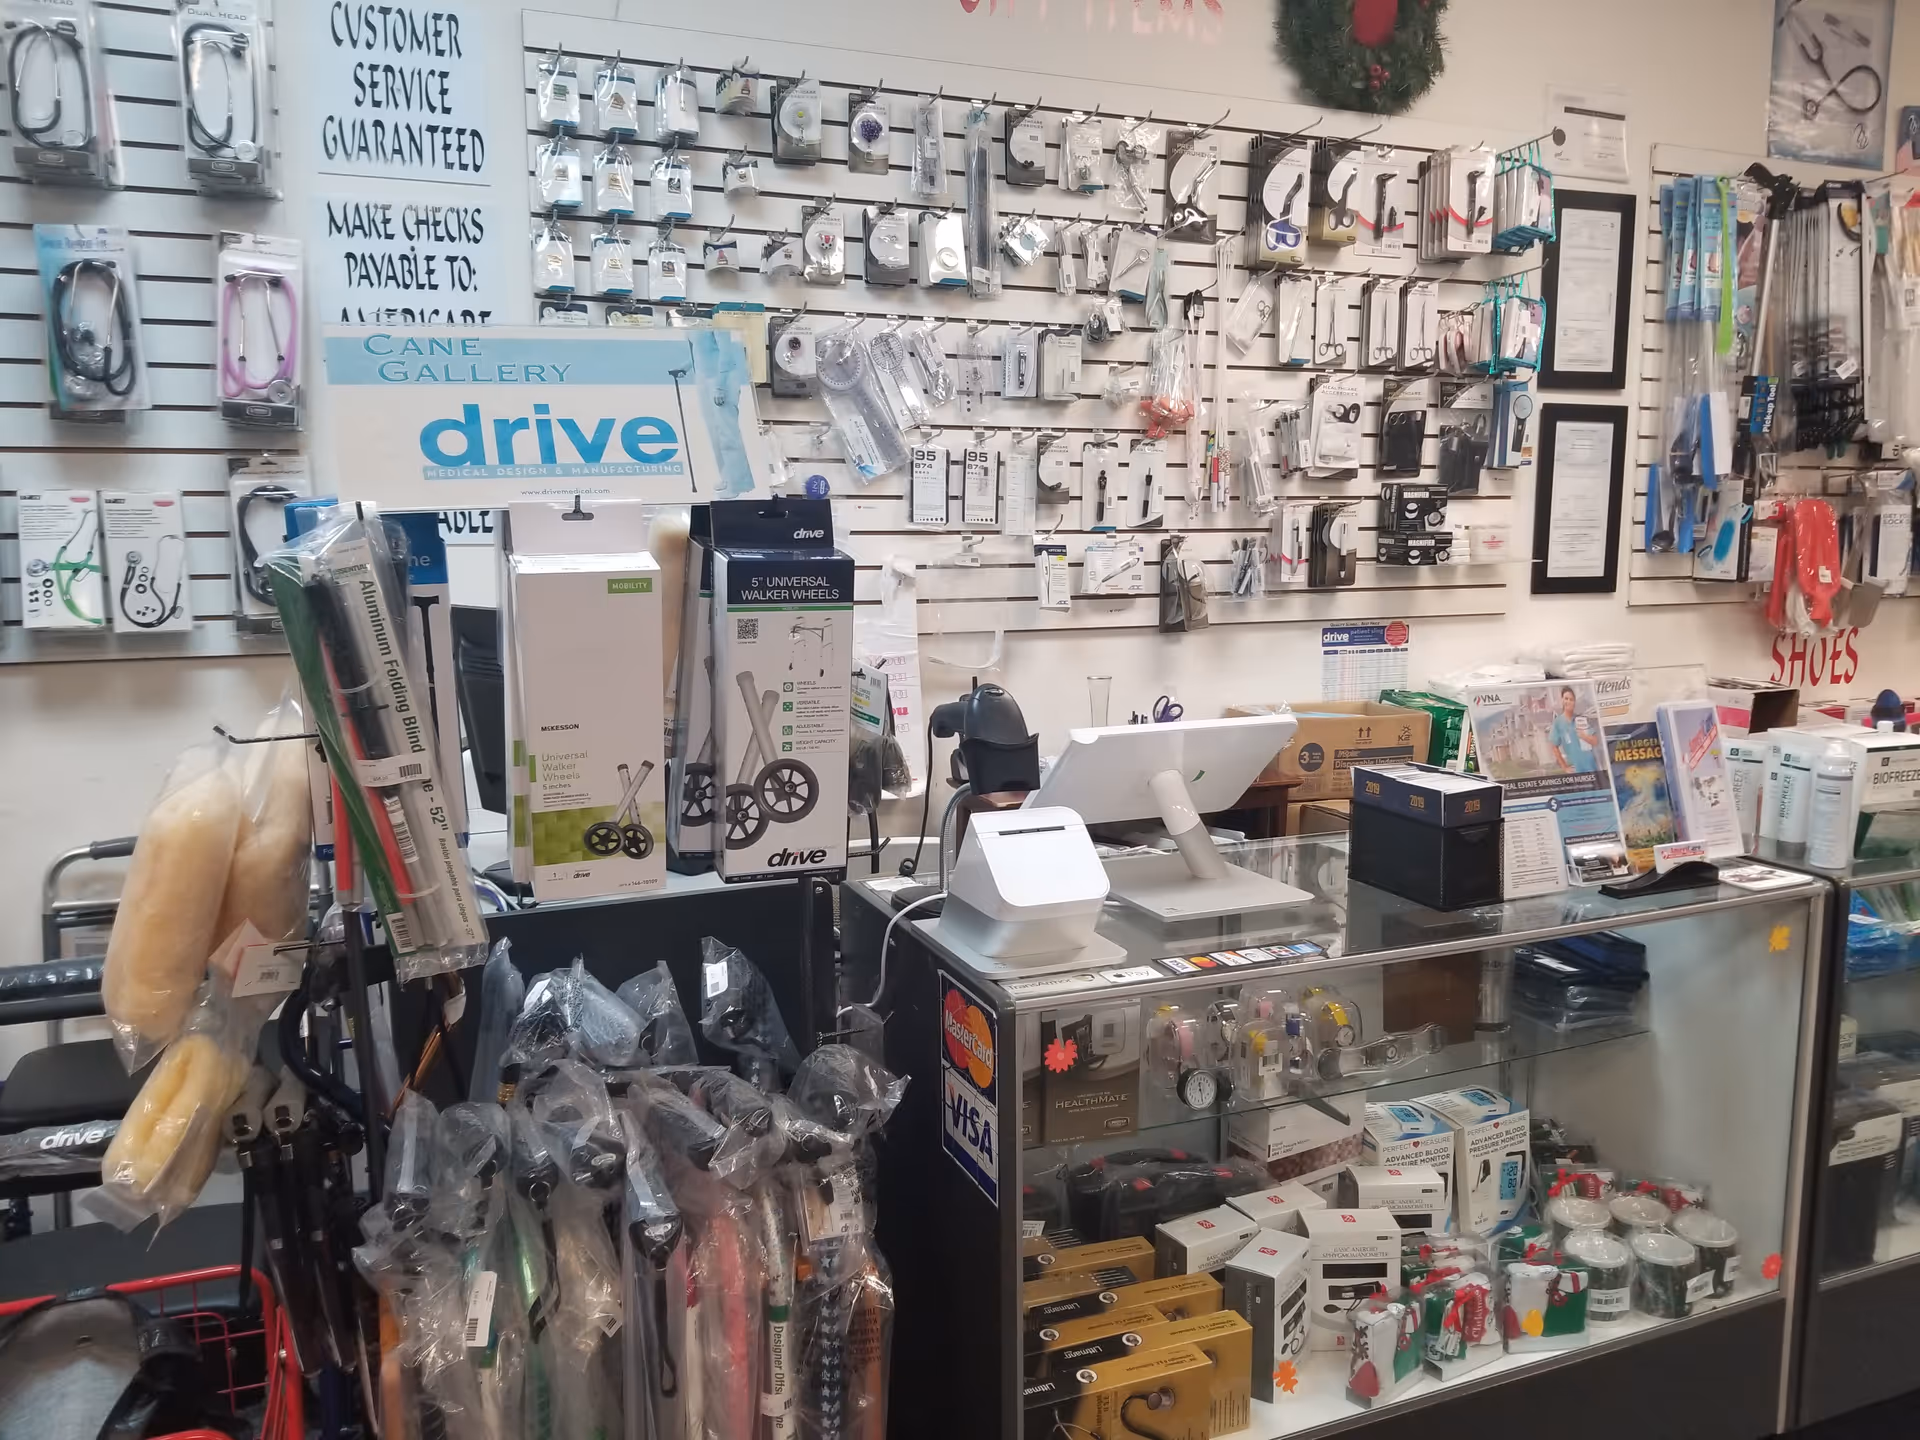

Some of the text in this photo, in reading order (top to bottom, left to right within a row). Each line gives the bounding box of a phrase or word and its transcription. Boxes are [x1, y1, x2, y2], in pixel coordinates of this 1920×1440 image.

[187, 7, 247, 21] DUAL HEAD
[330, 1, 462, 59] CUSTOMER
[353, 61, 452, 115] SERVICE
[322, 115, 485, 173] GUARANTEED
[326, 200, 484, 245] MAKE CHECKS
[343, 251, 478, 292] PAYABLE TO:
[362, 332, 482, 356] CANE
[377, 360, 572, 383] GALLERY
[1762, 384, 1777, 432] Pick-up Tool
[419, 403, 679, 467] drive
[915, 450, 936, 461] 95
[968, 451, 988, 462] 95
[426, 467, 488, 478] MEDICAL
[497, 466, 547, 476] DESIGN
[571, 463, 682, 475] MANUFACTURING
[793, 528, 824, 541] drive
[612, 582, 648, 591] MOBILITY
[766, 576, 830, 587] UNIVERSAL
[741, 589, 840, 600] WALKER WHEELS
[1323, 632, 1349, 641] drive
[1770, 626, 1859, 687] SHOES
[358, 579, 393, 657] Aluminum
[384, 660, 410, 713] Folding
[402, 716, 426, 754] Blind
[1480, 694, 1501, 704] VNA
[541, 750, 588, 762] Universal
[1300, 751, 1309, 764] 3
[542, 762, 576, 772] Walker
[543, 772, 581, 782] Wheels
[1518, 781, 1537, 789] ESTATE
[1539, 778, 1562, 787] SAVINGS
[1574, 774, 1596, 783] NURSES
[1873, 770, 1920, 785] BIOFREEZE
[1779, 775, 1792, 818] BIOFREEZE
[767, 847, 827, 867] drive
[573, 871, 591, 879] drive
[1008, 978, 1072, 992] TransArmor
[944, 1009, 992, 1070] MasterCard
[1055, 1093, 1128, 1109] HEALTHMATE
[948, 1090, 993, 1166] VISA
[1467, 1115, 1527, 1136] PERFECT MEASURE
[40, 1129, 106, 1150] drive
[1469, 1132, 1527, 1154] PRESSURE MONITOR
[1470, 1125, 1525, 1146] ADVANCED BLOOD
[1382, 1136, 1450, 1153] PERFECT MEASURE
[1385, 1147, 1449, 1163] ADVANCED BLOOD
[1420, 1153, 1450, 1165] MONITOR
[1043, 1302, 1080, 1315] Littmann
[772, 1326, 786, 1370] Designer
[1064, 1345, 1102, 1359] Littmann
